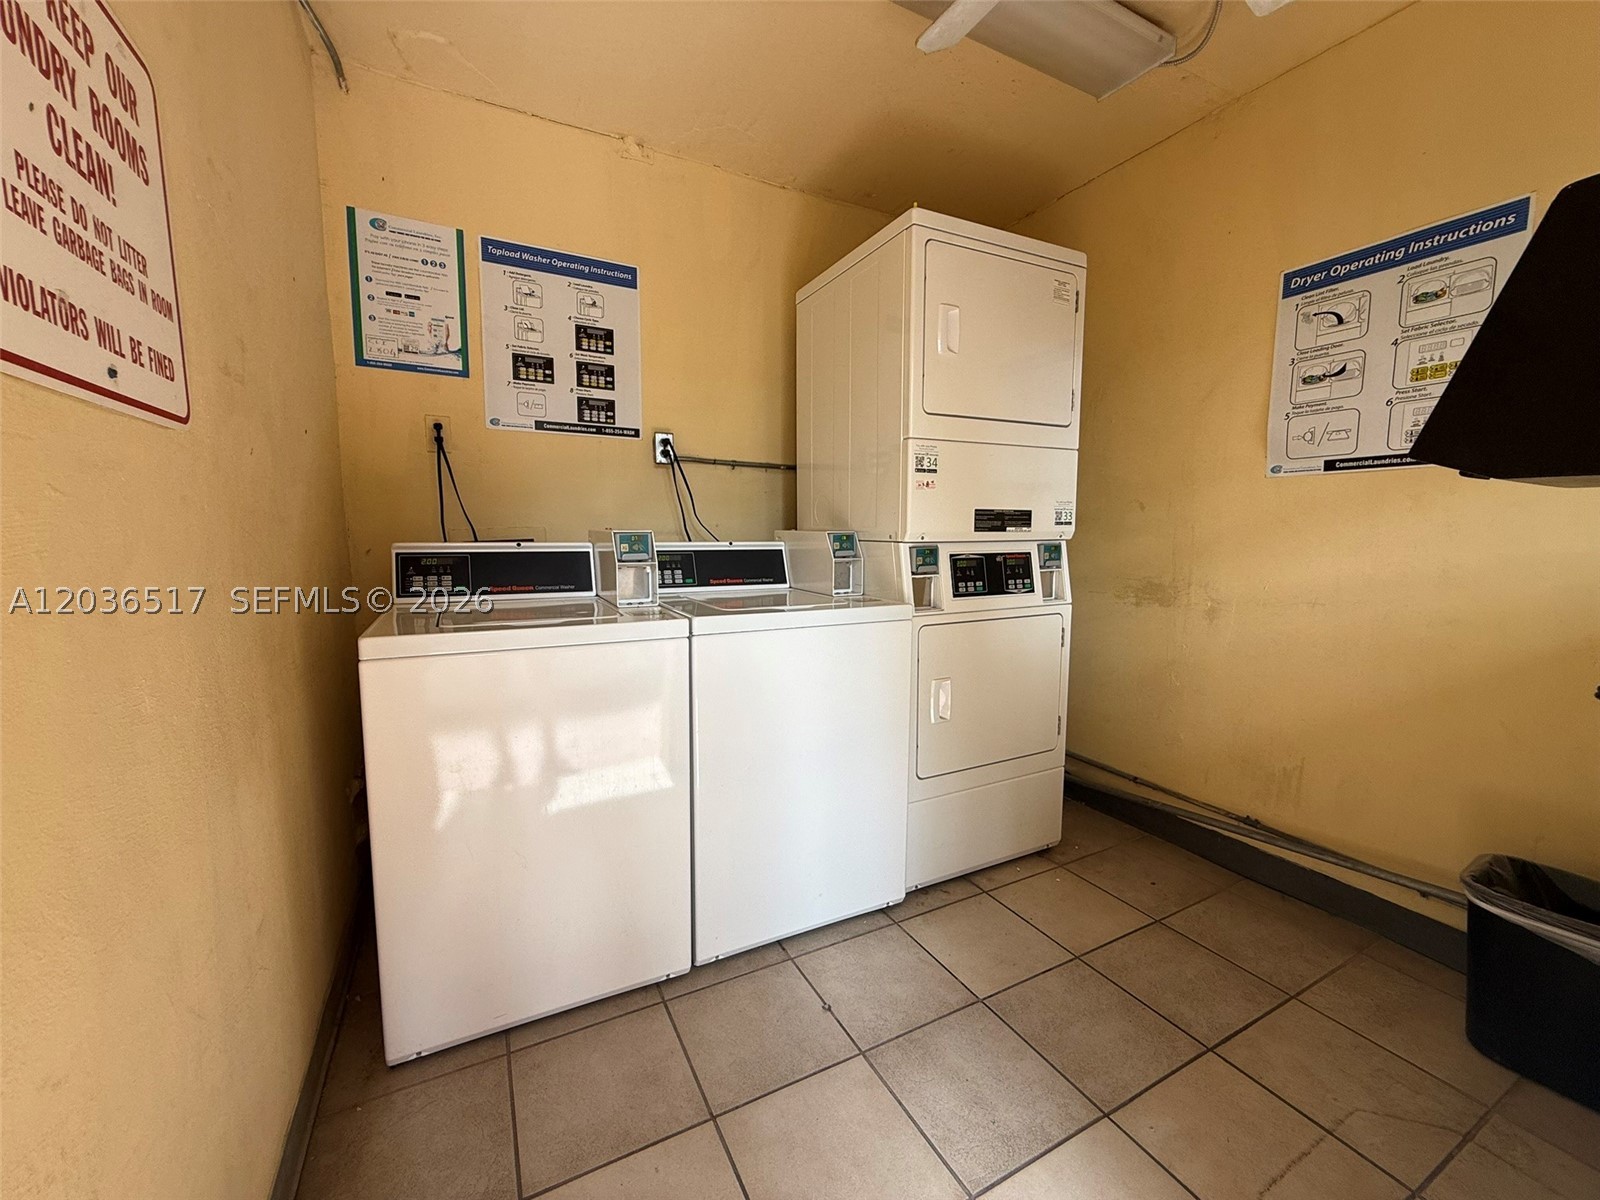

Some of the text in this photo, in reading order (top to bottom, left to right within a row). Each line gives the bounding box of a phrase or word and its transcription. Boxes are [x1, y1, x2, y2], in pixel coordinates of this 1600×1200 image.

[104, 51, 140, 128] OUR
[88, 85, 150, 187] ROOMS
[46, 102, 117, 208] CLEAN!
[13, 148, 149, 279] PLEASE DO NOT LITTER
[1, 176, 174, 323] LEAVE GARBAGE BAGS IN ROOM
[1290, 213, 1517, 289] Dryer Operating Instructions
[487, 246, 632, 280] Topload Washer Operating Instructions
[1407, 262, 1423, 271] Load
[1397, 274, 1405, 284] 2
[1295, 303, 1299, 311] 1
[0, 264, 175, 382] VIOLATORS WILL BE FINED
[1410, 324, 1429, 333] Fabric
[1391, 338, 1398, 346] 4
[1289, 358, 1295, 366] 3
[1385, 397, 1393, 406] 6
[1284, 412, 1290, 420] 5
[926, 456, 938, 468] 34
[1063, 511, 1073, 521] 33
